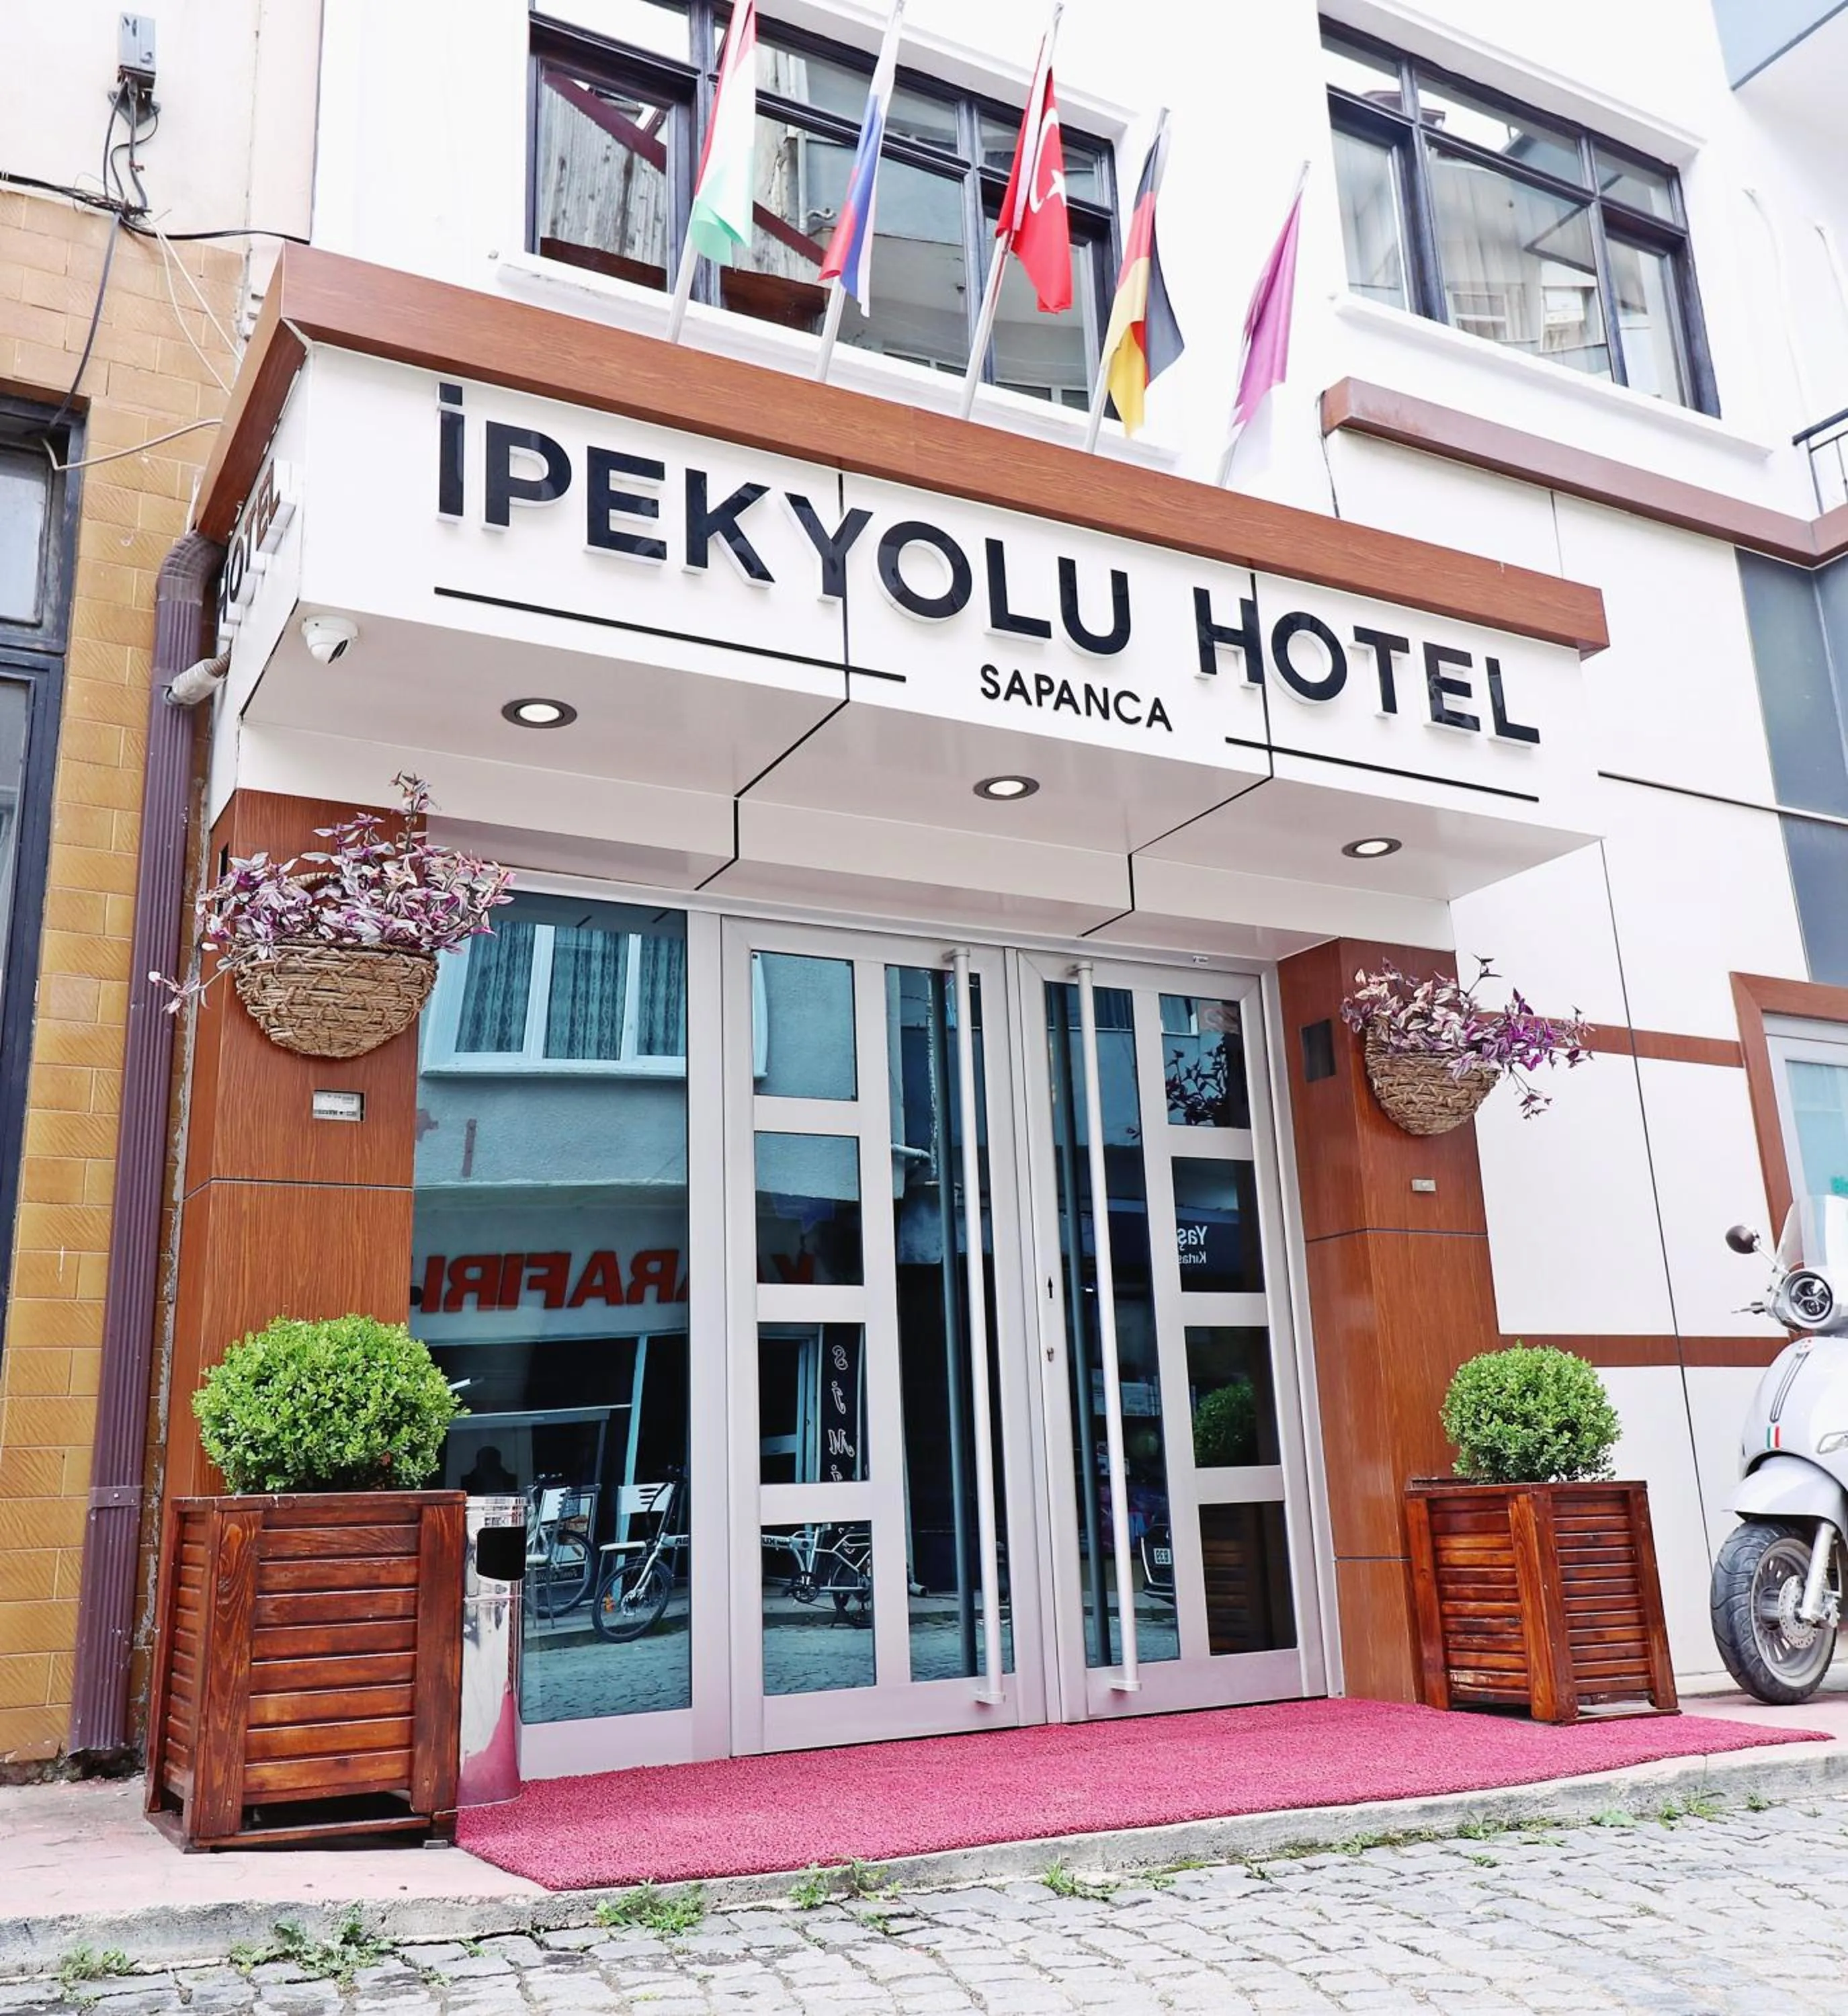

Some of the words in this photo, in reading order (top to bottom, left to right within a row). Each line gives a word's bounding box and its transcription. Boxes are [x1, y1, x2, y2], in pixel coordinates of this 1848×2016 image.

[438, 381, 1132, 655] İPEKYOLU
[1193, 586, 1541, 744] HOTEL
[980, 663, 1173, 732] SAPANCA
